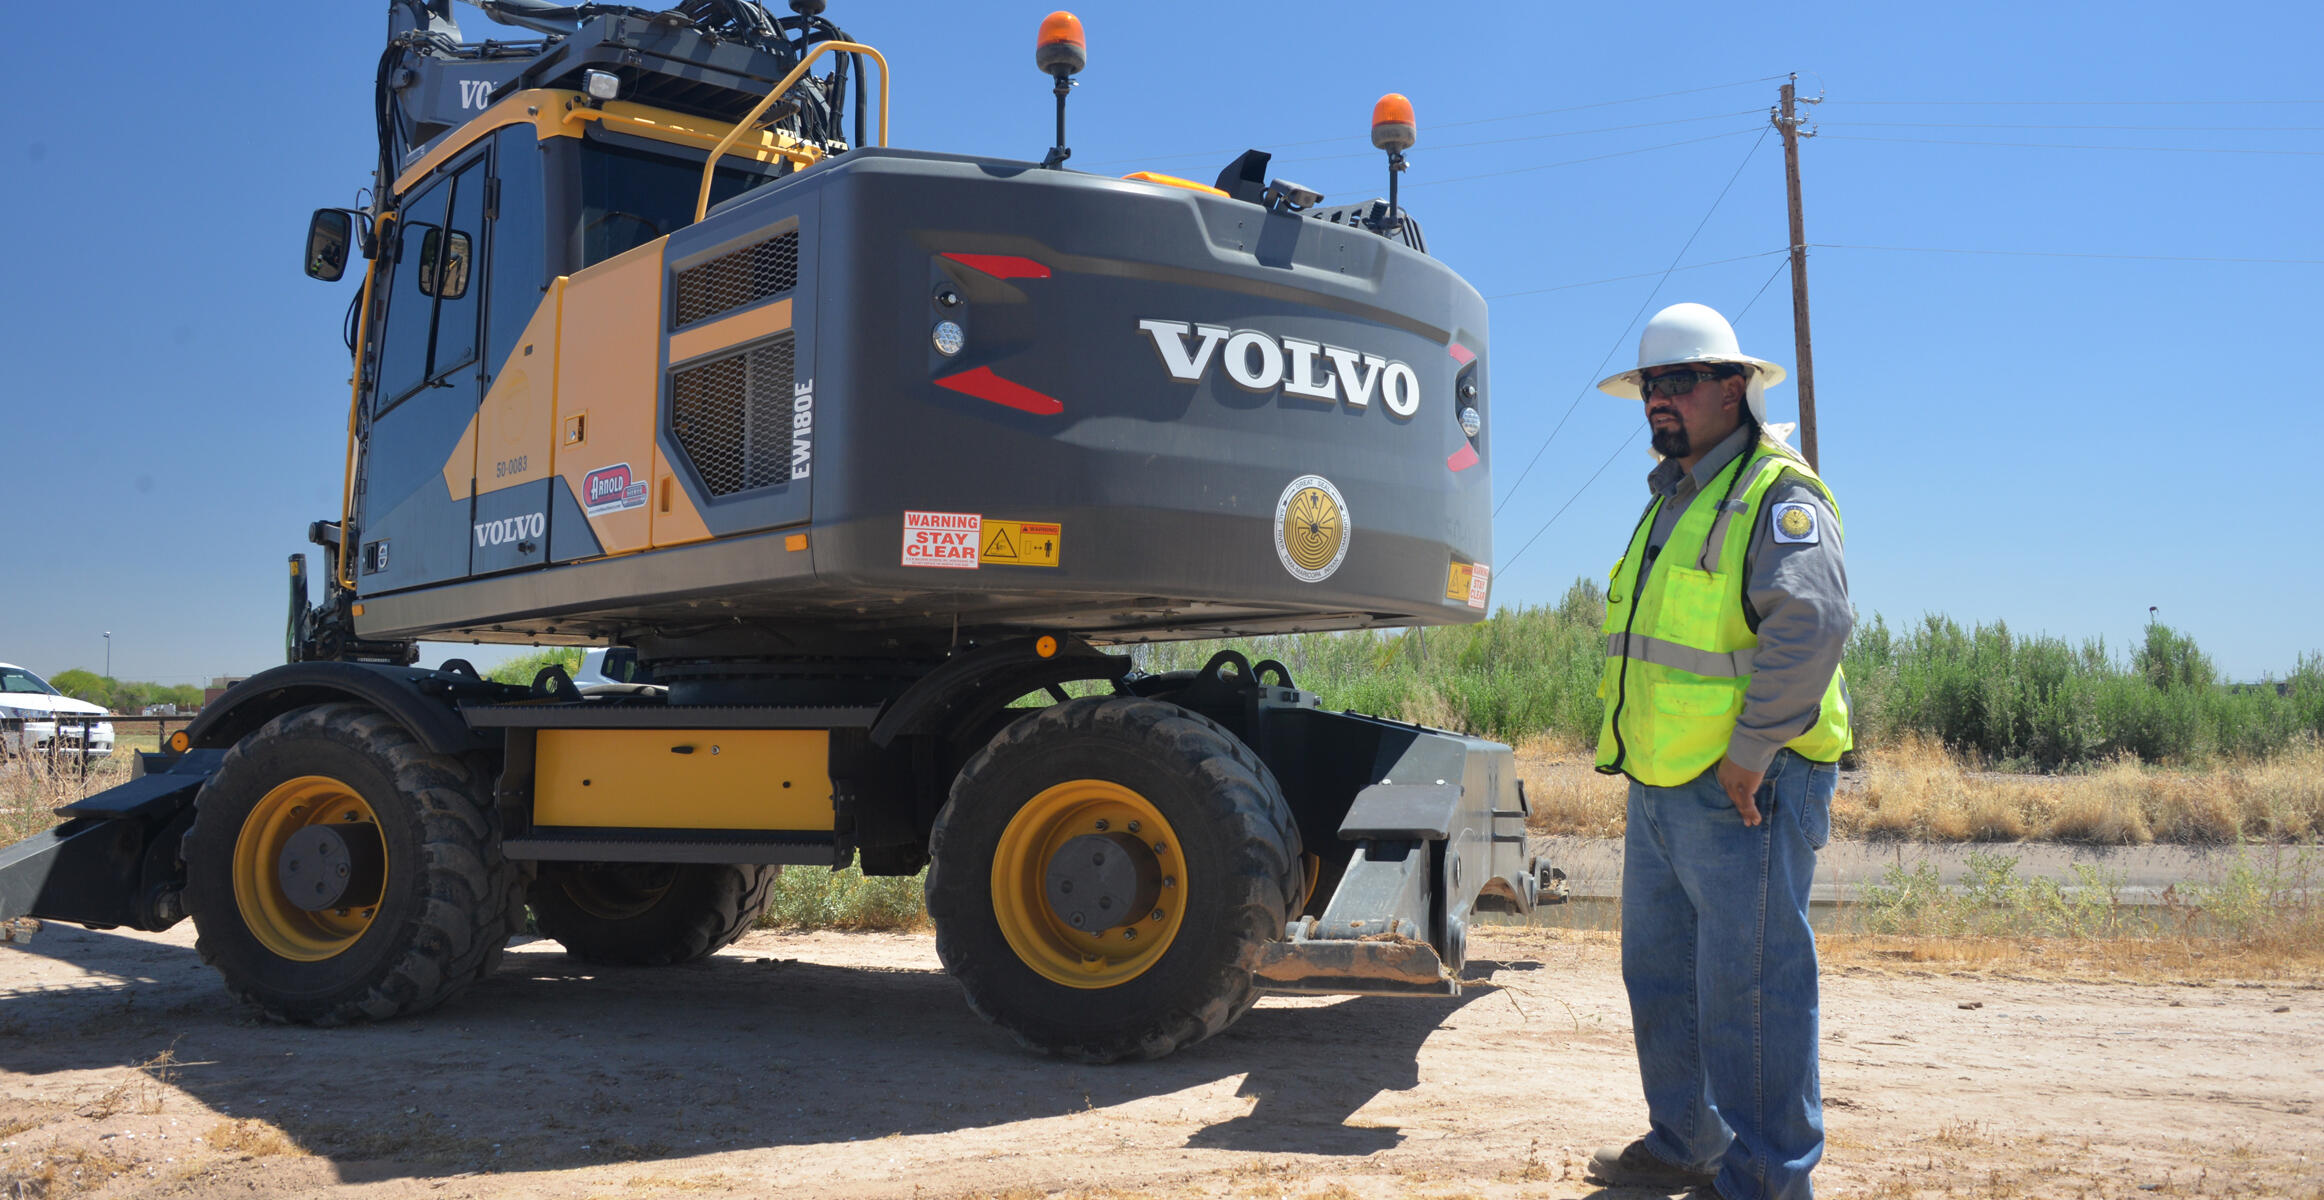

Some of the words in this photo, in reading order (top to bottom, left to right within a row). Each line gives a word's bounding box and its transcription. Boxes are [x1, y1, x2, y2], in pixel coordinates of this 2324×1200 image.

[459, 80, 497, 110] VO
[1138, 319, 1420, 417] VOLVO
[792, 378, 813, 480] EW180E
[496, 455, 528, 478] 50-0083
[591, 475, 624, 501] ARNOLD
[474, 512, 545, 547] VOLVO
[908, 513, 978, 529] WARNING
[906, 544, 976, 559] CLEAR
[916, 531, 968, 546] STAY
